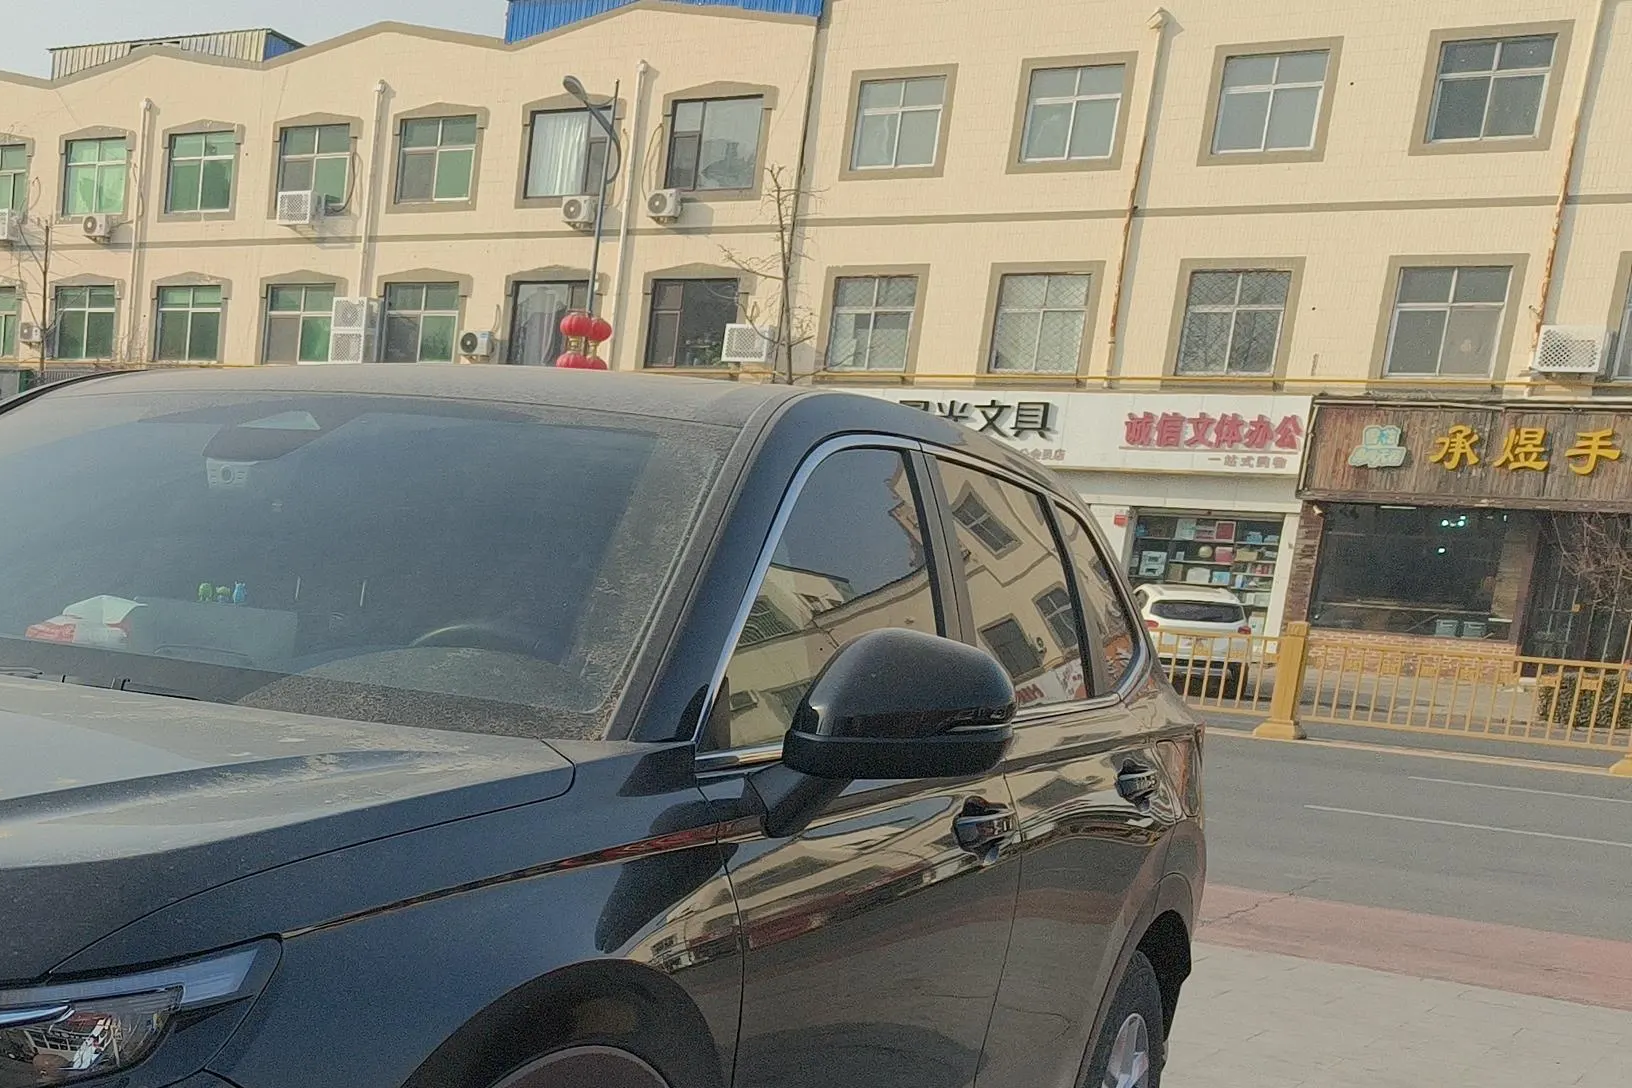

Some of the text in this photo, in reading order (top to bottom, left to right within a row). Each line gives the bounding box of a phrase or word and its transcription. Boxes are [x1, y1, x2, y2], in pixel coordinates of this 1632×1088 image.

[1125, 412, 1303, 449] 诚信文体办公
[1429, 425, 1620, 475] 承煜手
